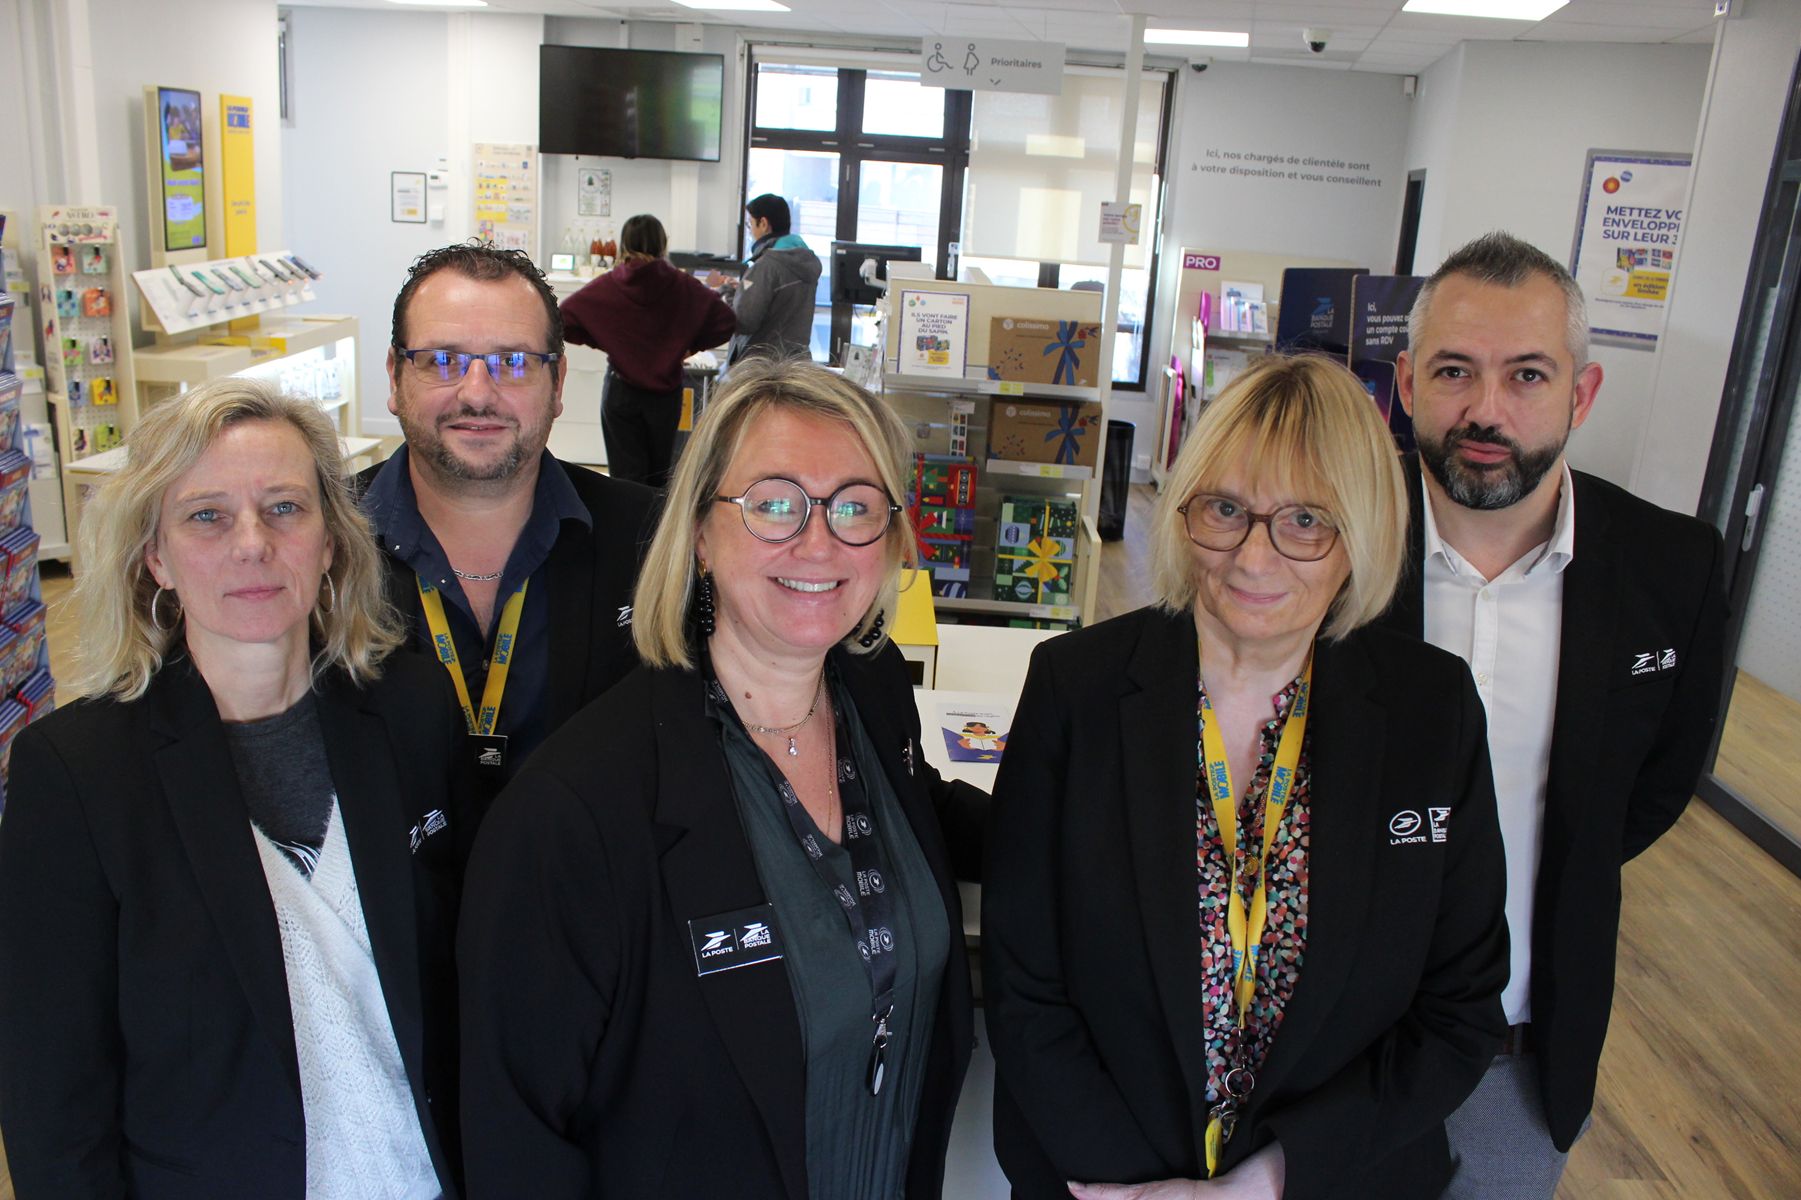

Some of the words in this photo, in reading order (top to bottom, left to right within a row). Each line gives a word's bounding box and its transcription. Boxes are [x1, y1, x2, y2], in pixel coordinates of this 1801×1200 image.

[991, 57, 1042, 69] Prioritaires
[1206, 149, 1220, 159] Ici,
[1223, 152, 1242, 160] nos
[1244, 152, 1284, 164] chargés
[1287, 156, 1300, 165] de
[1302, 157, 1345, 169] clientèle
[1347, 161, 1370, 171] sont
[1200, 165, 1226, 174] votre
[1229, 167, 1285, 179] disposition
[1287, 171, 1298, 180] et
[1300, 173, 1324, 182] vous
[1326, 175, 1382, 187] conseillent
[1606, 205, 1662, 220] METTEZ
[1602, 229, 1630, 240] SUR
[1633, 232, 1670, 244] LEUR
[1185, 256, 1217, 269] PRO
[1367, 302, 1376, 312] Ici,
[1016, 321, 1050, 330] colissimo
[1382, 316, 1403, 324] pouvez
[1376, 326, 1398, 334] compte
[1380, 336, 1394, 344] RDV
[1018, 409, 1051, 418] colissimo
[434, 634, 452, 664] MOBILE
[496, 634, 513, 664] MOBILE
[1209, 763, 1219, 789] POSTE
[1214, 760, 1231, 800] MOBILE
[1286, 768, 1292, 779] LA
[1270, 766, 1288, 805] MOBILE
[1280, 778, 1291, 806] POSTE
[1215, 789, 1220, 800] LA
[851, 822, 859, 839] POSTE
[856, 871, 867, 897] MOBILE
[863, 878, 871, 896] POSTE
[743, 934, 770, 944] BANQUE
[744, 939, 772, 949] POSTALE
[868, 929, 878, 955] MOBILE
[712, 946, 734, 956] POSTE
